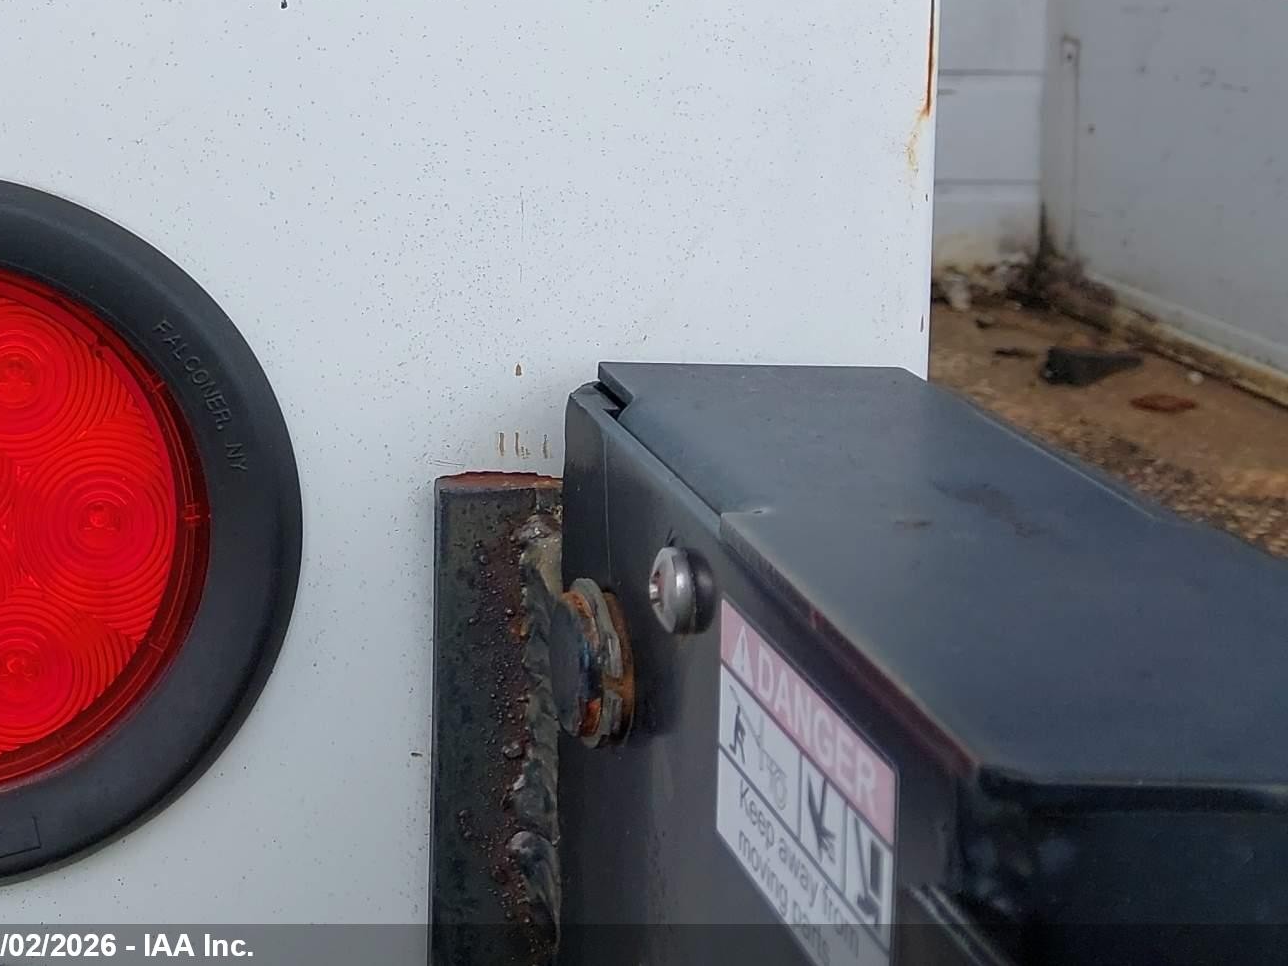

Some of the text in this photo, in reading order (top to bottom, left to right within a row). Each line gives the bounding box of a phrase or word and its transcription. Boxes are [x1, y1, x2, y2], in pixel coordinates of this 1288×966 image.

[225, 442, 249, 471] NY
[758, 646, 877, 820] DANGER
[738, 830, 831, 966] moving parts
[739, 780, 860, 958] Keep away from
